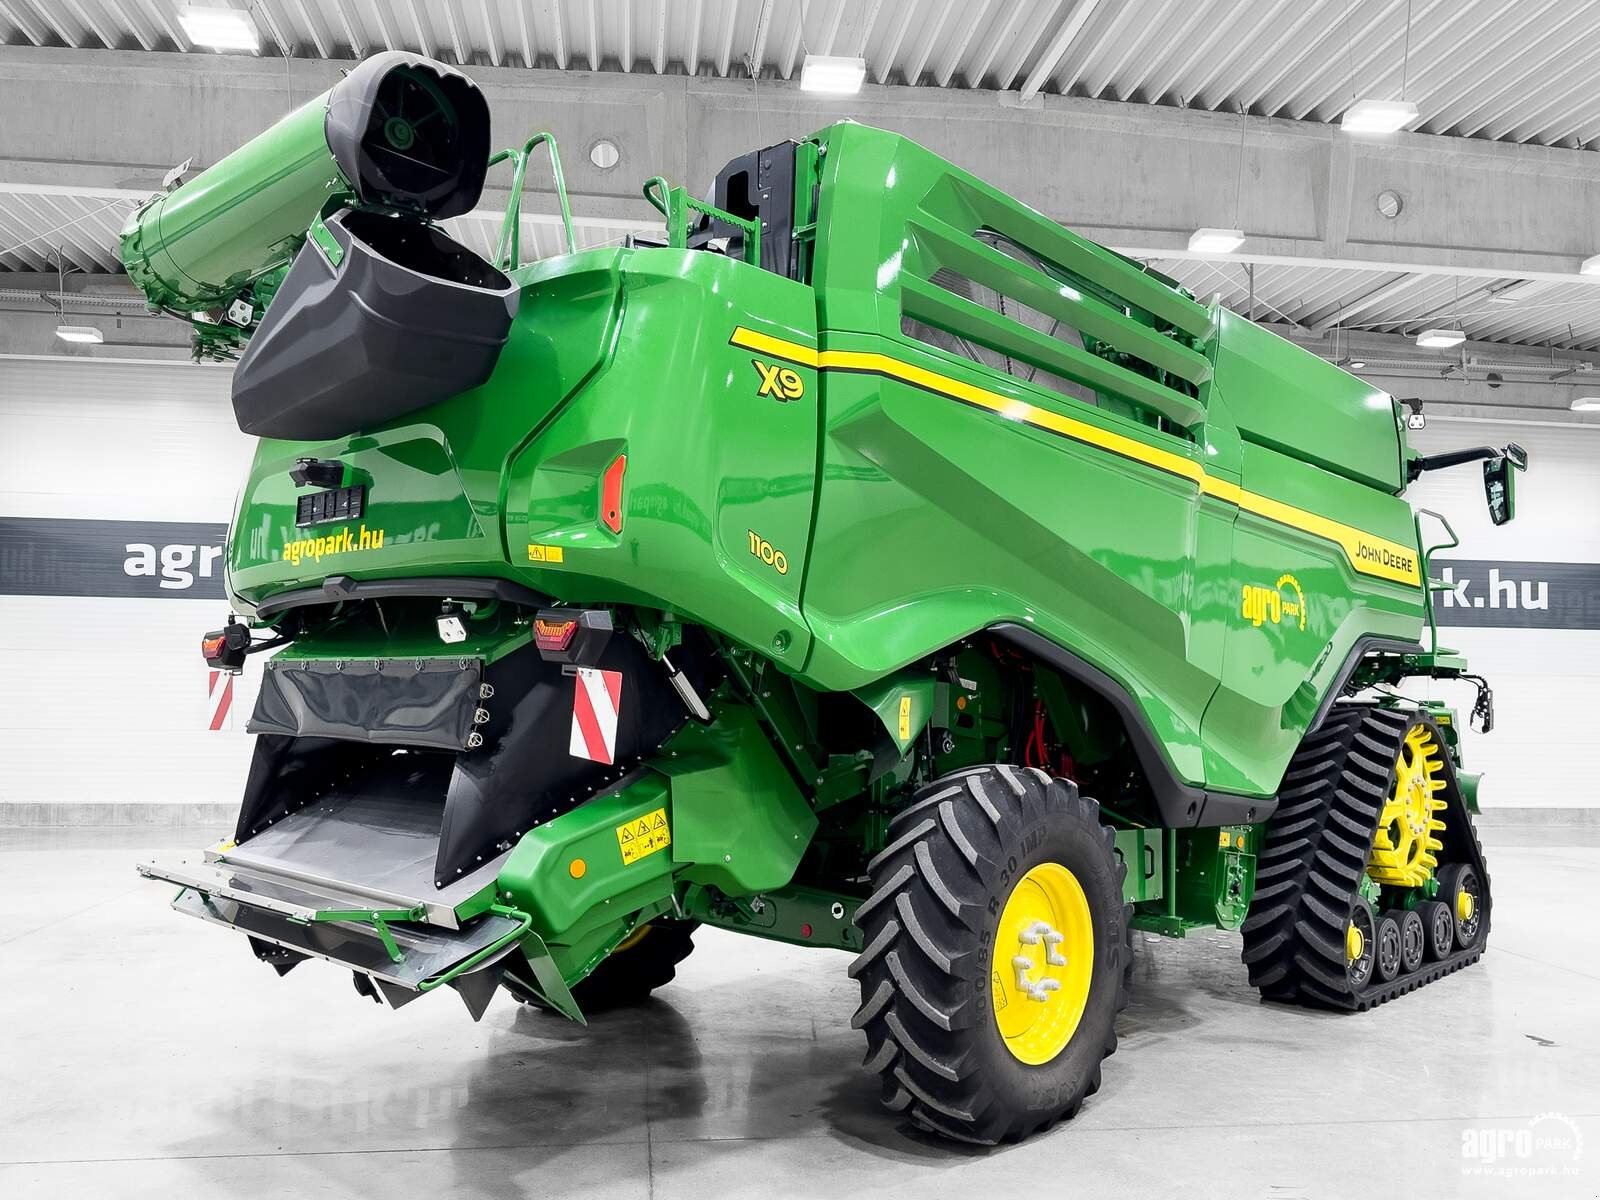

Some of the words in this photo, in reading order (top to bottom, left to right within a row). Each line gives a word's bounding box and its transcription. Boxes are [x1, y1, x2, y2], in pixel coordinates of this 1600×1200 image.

[751, 359, 804, 403] X9
[283, 524, 385, 566] agropark.hu
[747, 528, 789, 576] 1100
[1355, 540, 1382, 564] JOHN
[1383, 548, 1413, 573] DEERE
[1242, 584, 1281, 627] agro
[1281, 601, 1300, 617] PARK
[1430, 567, 1548, 610] k.hu
